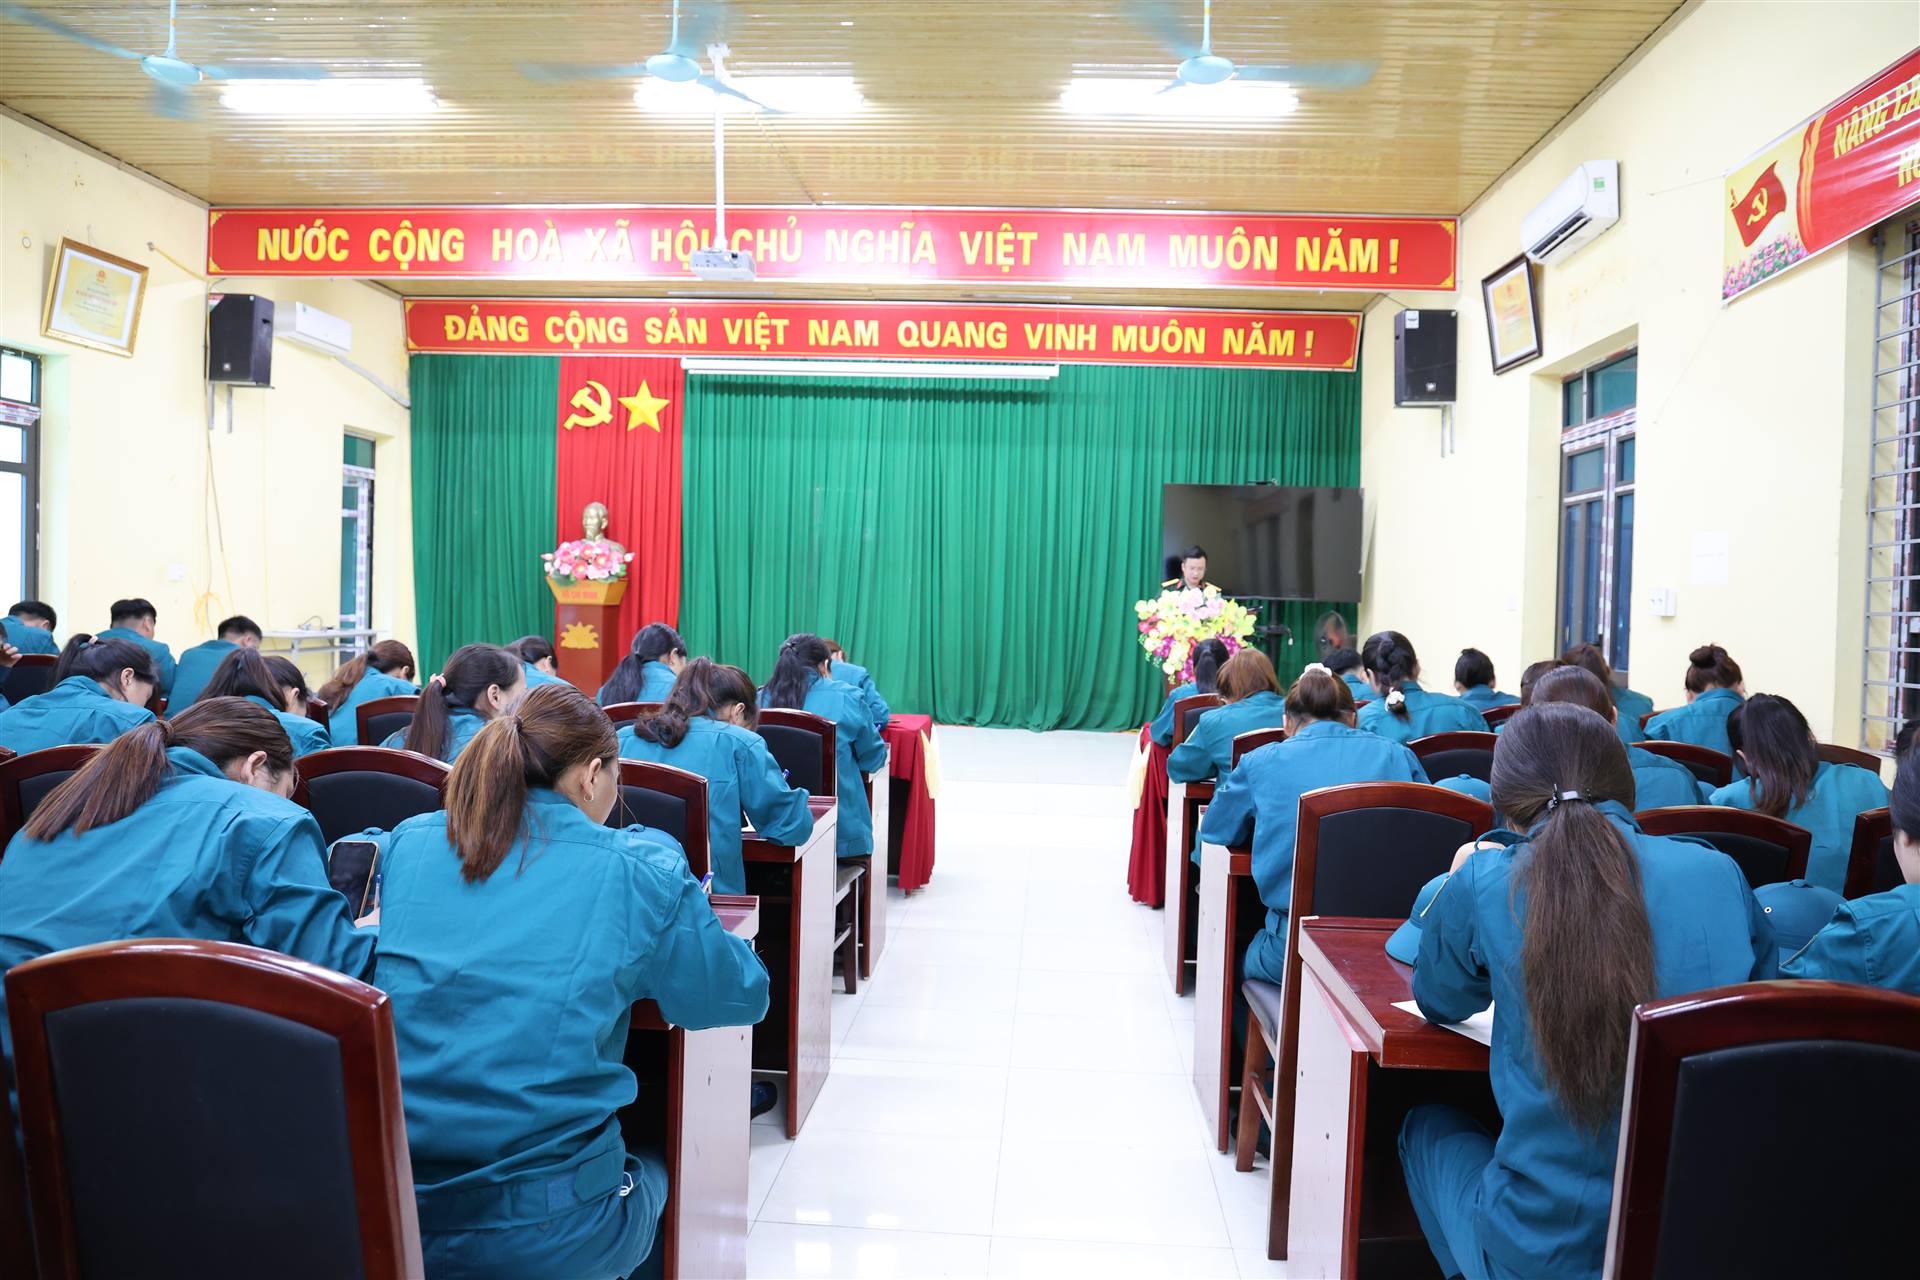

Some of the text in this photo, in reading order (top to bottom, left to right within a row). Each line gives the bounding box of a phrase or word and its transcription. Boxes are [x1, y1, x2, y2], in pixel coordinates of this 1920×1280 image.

[1834, 97, 1889, 159] NÂNG
[257, 219, 349, 262] NƯỚC
[369, 220, 465, 271] CỘNG
[491, 220, 563, 263] HOÀ
[584, 219, 633, 263] XÃ
[649, 219, 710, 271] HỘI
[730, 215, 804, 264] CHỦ
[824, 221, 937, 266] NGHĨA
[960, 222, 1039, 274] VIỆT
[1062, 231, 1146, 268] NAM
[1168, 227, 1279, 271] MUÔN
[444, 305, 529, 342] ĐẢNG
[544, 310, 629, 351] CỘNG
[645, 307, 708, 345] SẢN
[722, 311, 790, 351] VIỆT
[807, 319, 880, 348] NAM
[897, 319, 1008, 349] QUANG
[1023, 323, 1097, 352] VINH
[1112, 318, 1206, 355] MUÔN
